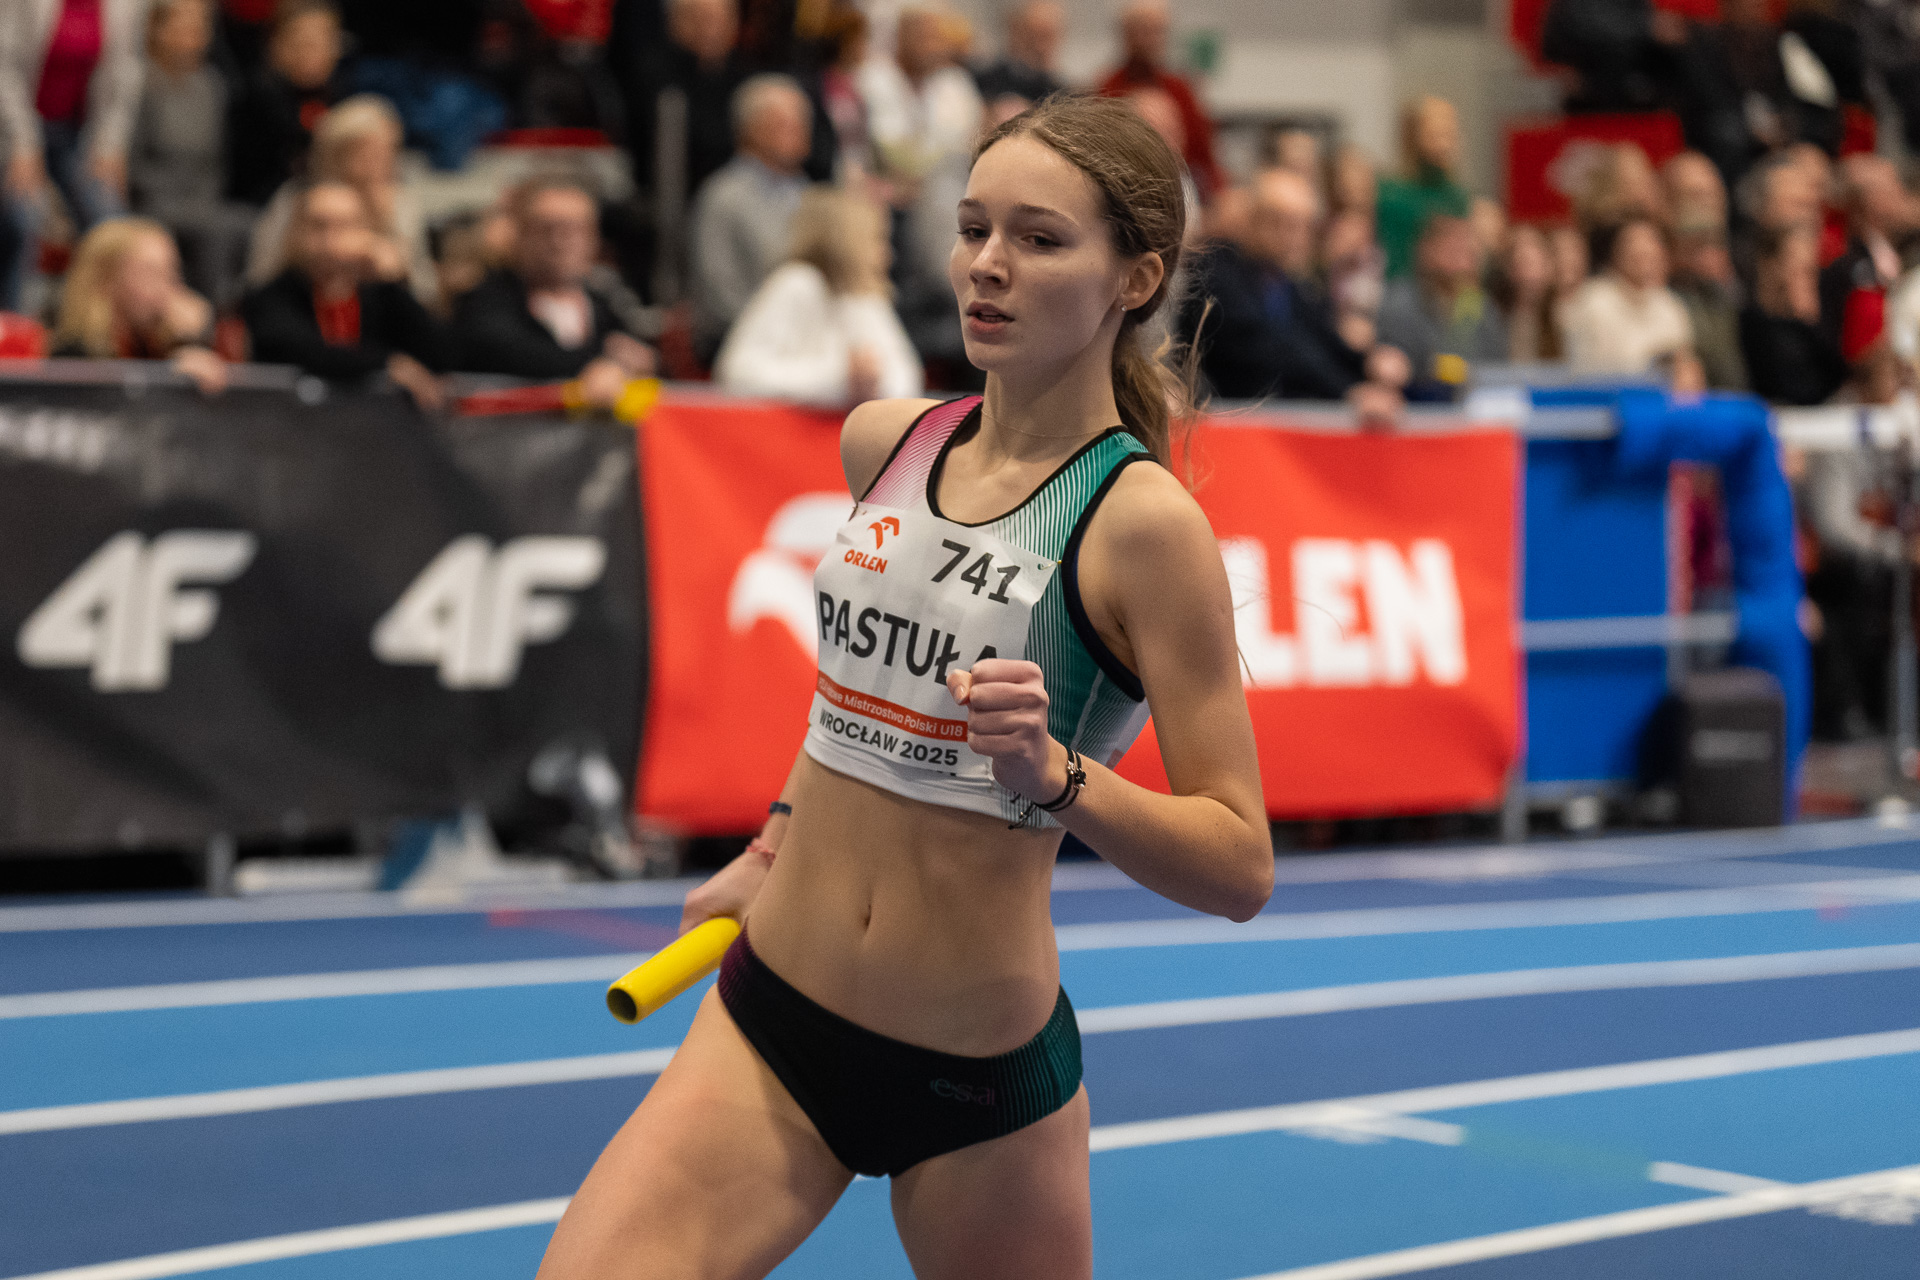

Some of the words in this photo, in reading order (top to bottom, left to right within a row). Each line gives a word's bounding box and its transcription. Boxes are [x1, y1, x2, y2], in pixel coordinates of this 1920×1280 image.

[843, 549, 888, 574] ORLEN
[930, 538, 1021, 605] 741
[16, 529, 258, 692] 4F
[370, 534, 606, 691] 4F
[1217, 536, 1468, 689] LEN
[819, 707, 899, 753] WROCŁAW
[899, 740, 959, 766] 2025
[844, 694, 904, 724] Mistrzostwa
[904, 715, 937, 735] Polski
[940, 724, 964, 737] U18
